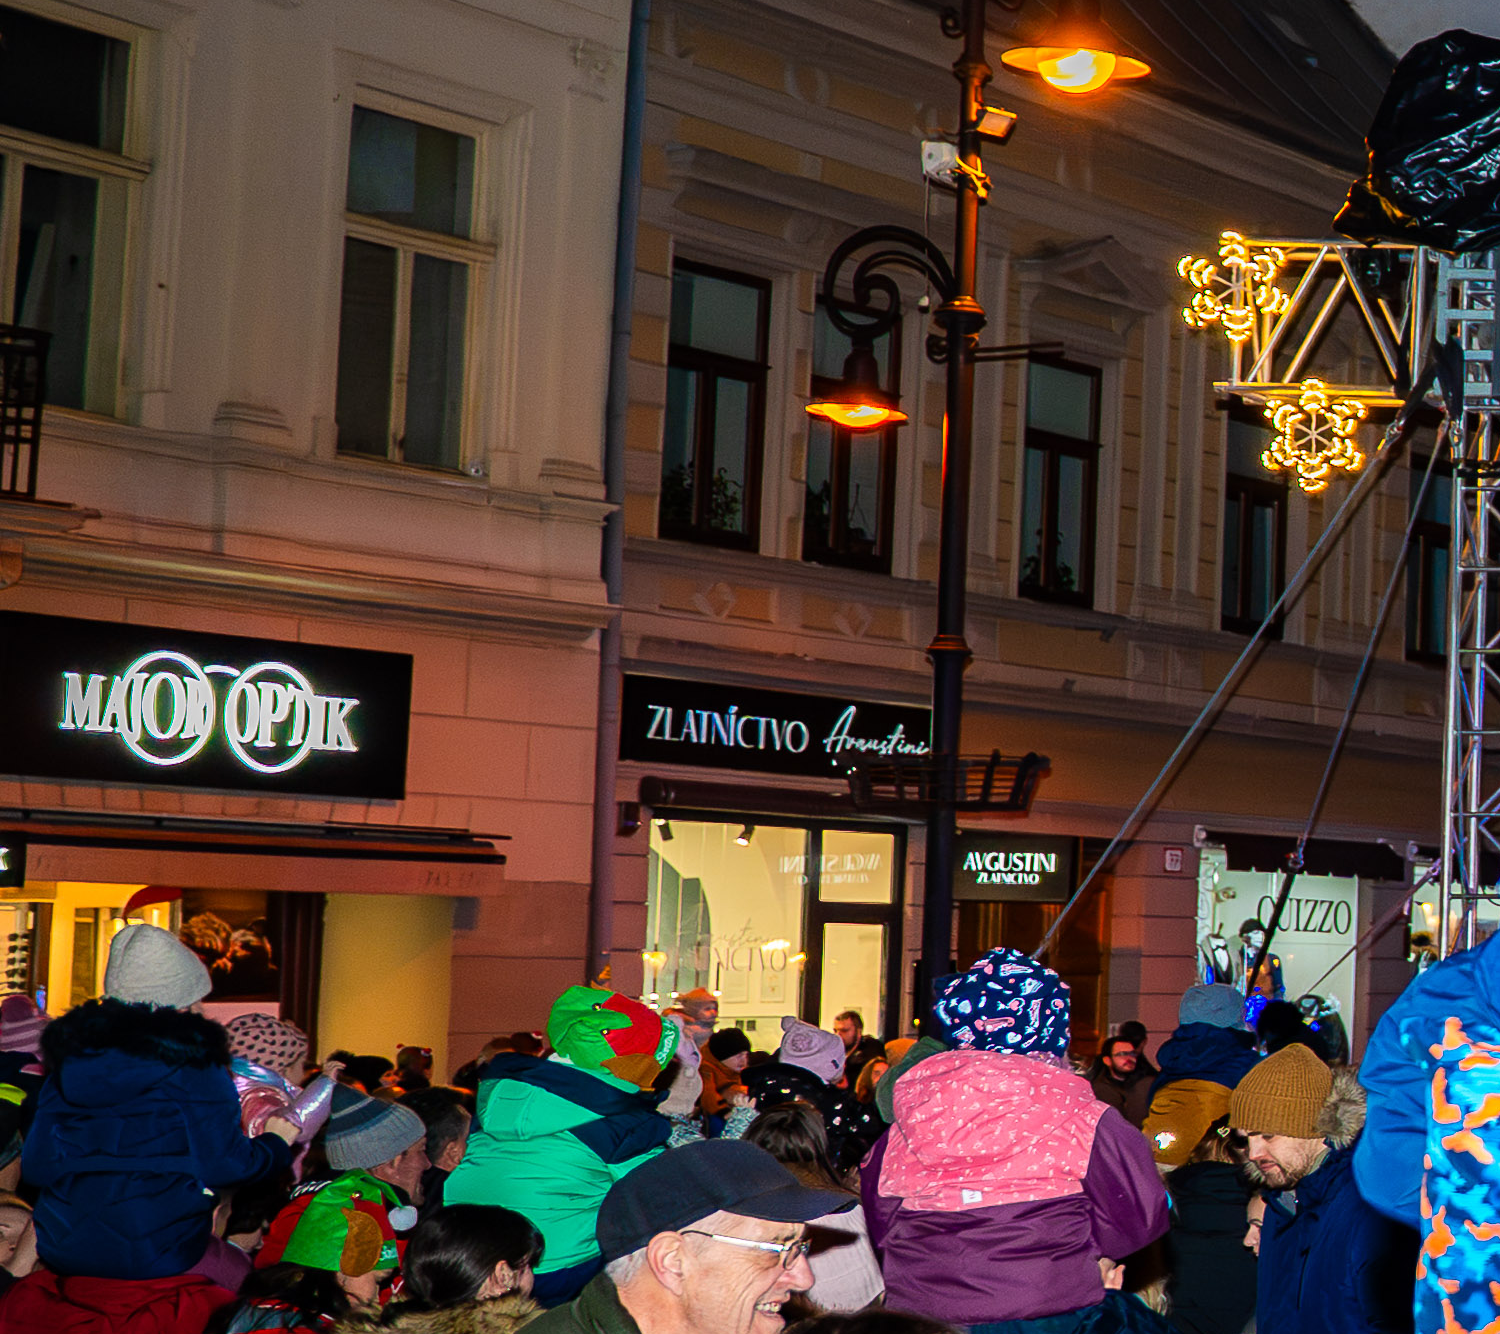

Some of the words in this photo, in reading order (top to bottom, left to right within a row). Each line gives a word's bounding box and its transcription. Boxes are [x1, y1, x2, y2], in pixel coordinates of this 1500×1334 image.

[59, 671, 215, 740] MAJOR
[225, 681, 361, 753] OPTIK
[646, 704, 811, 753] ZLATNÍCTVO
[1257, 895, 1352, 935] QUIZZO
